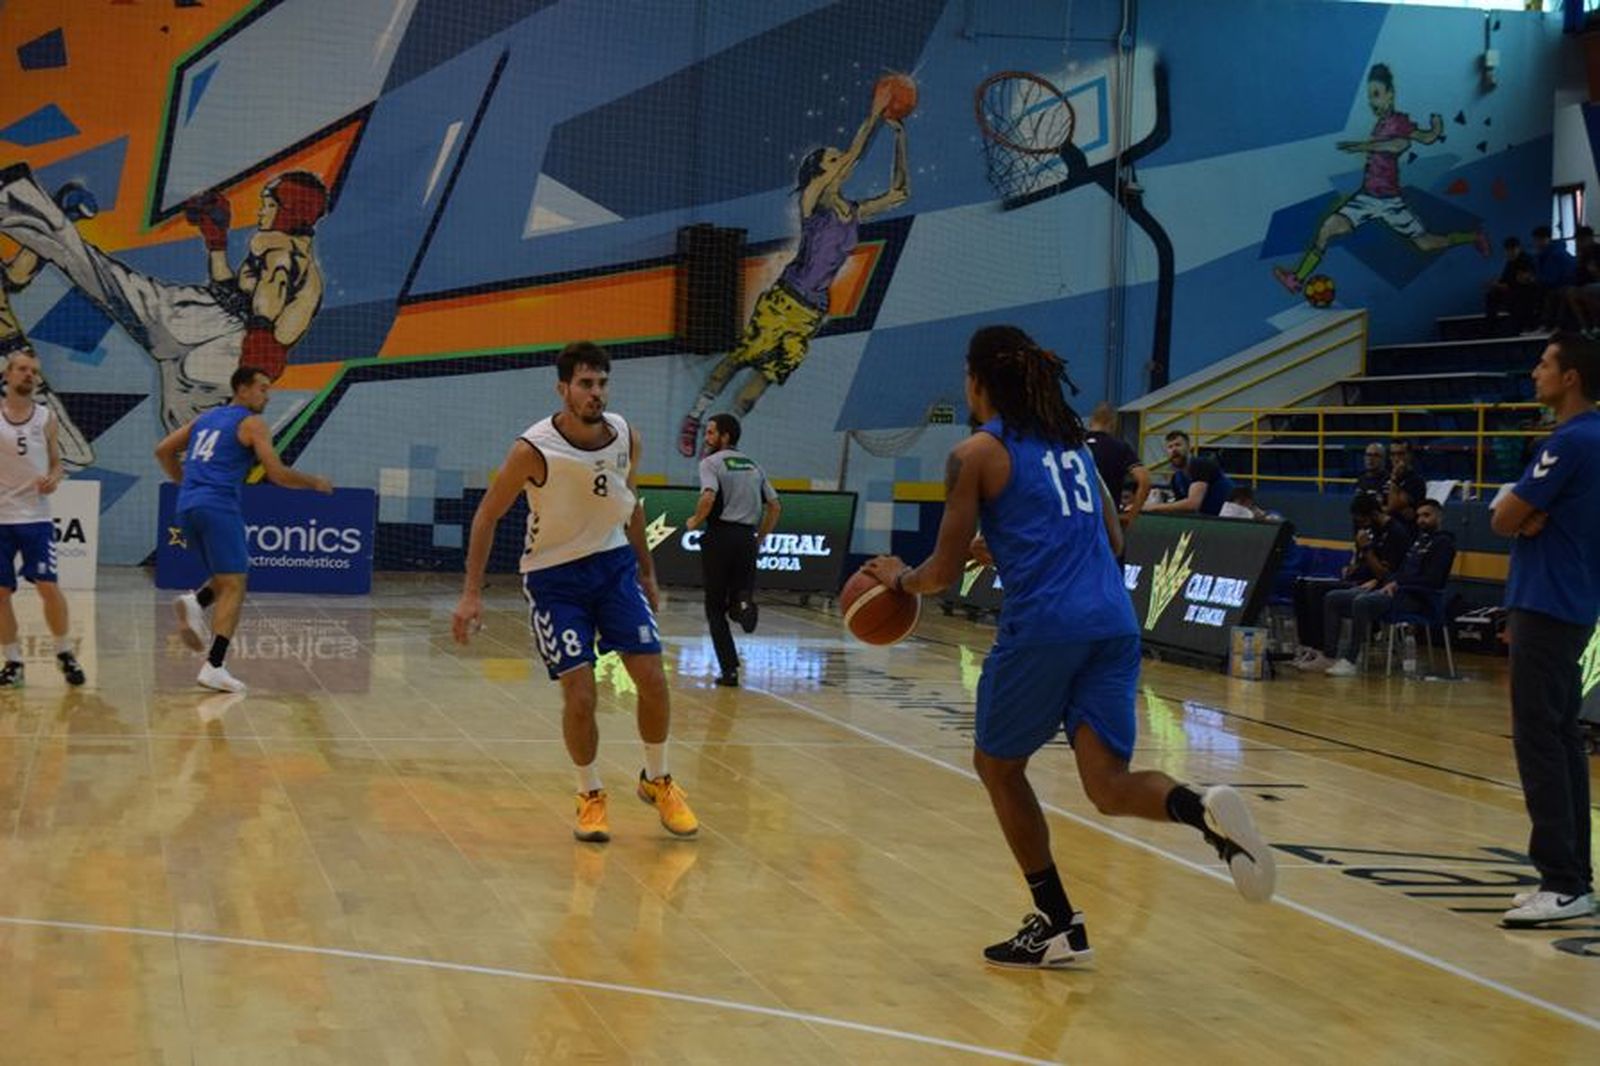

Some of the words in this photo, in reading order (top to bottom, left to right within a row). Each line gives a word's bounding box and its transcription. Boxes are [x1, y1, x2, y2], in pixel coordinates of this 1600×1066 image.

[16, 436, 28, 456] 5
[190, 428, 219, 463] 14
[592, 474, 608, 497] 8
[1042, 449, 1094, 517] 13
[758, 532, 831, 556] URAL
[562, 629, 582, 658] 8
